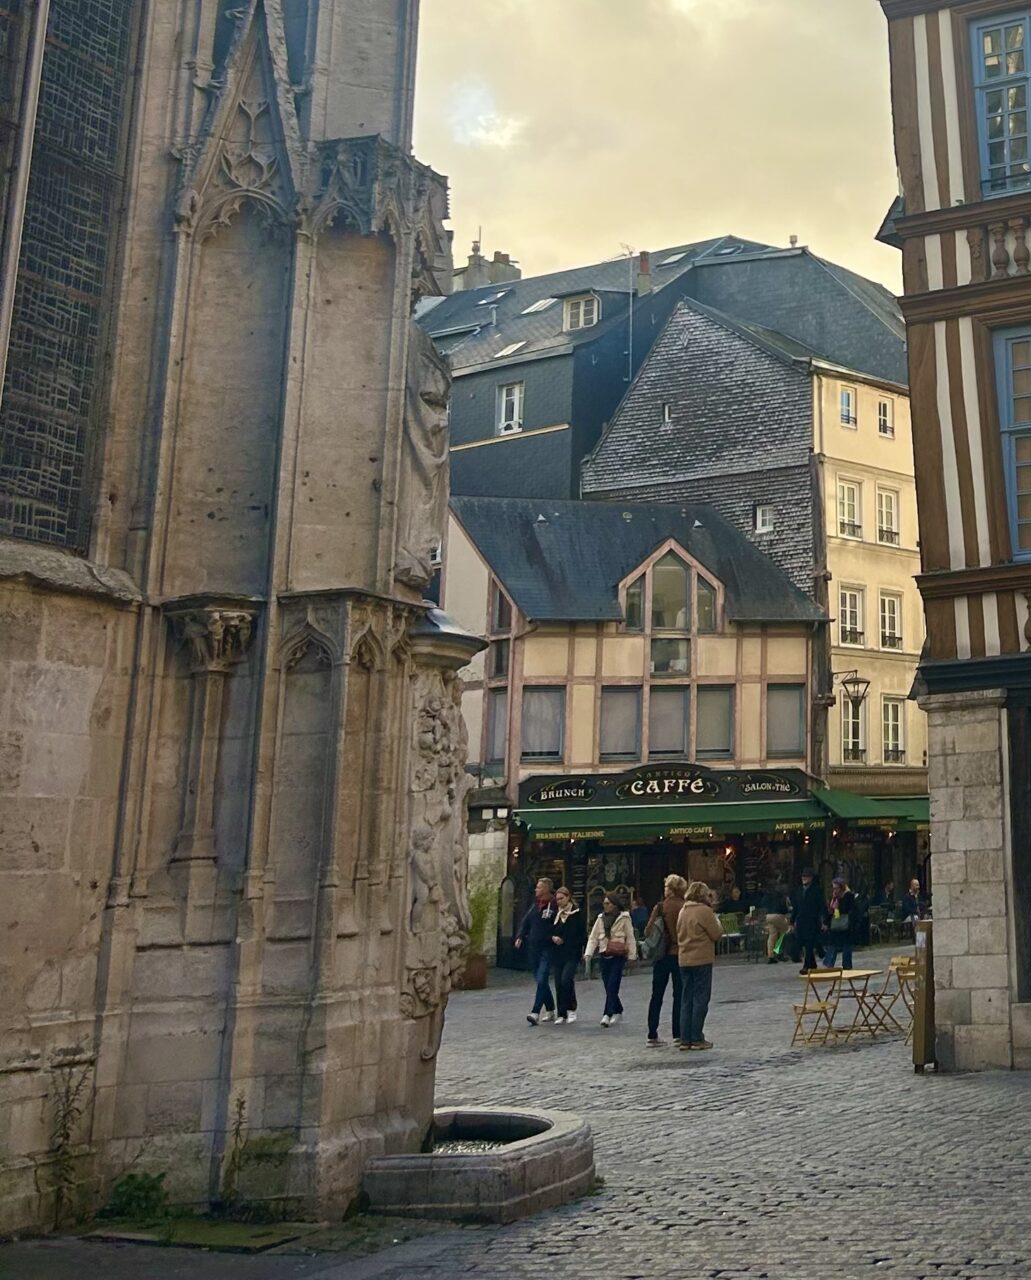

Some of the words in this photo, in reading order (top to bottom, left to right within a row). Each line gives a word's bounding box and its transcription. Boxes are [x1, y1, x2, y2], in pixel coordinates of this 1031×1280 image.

[645, 770, 692, 779] ANTICO
[744, 782, 773, 793] SALON
[540, 787, 585, 801] BRUNCH
[571, 830, 605, 839] ITALIENNE
